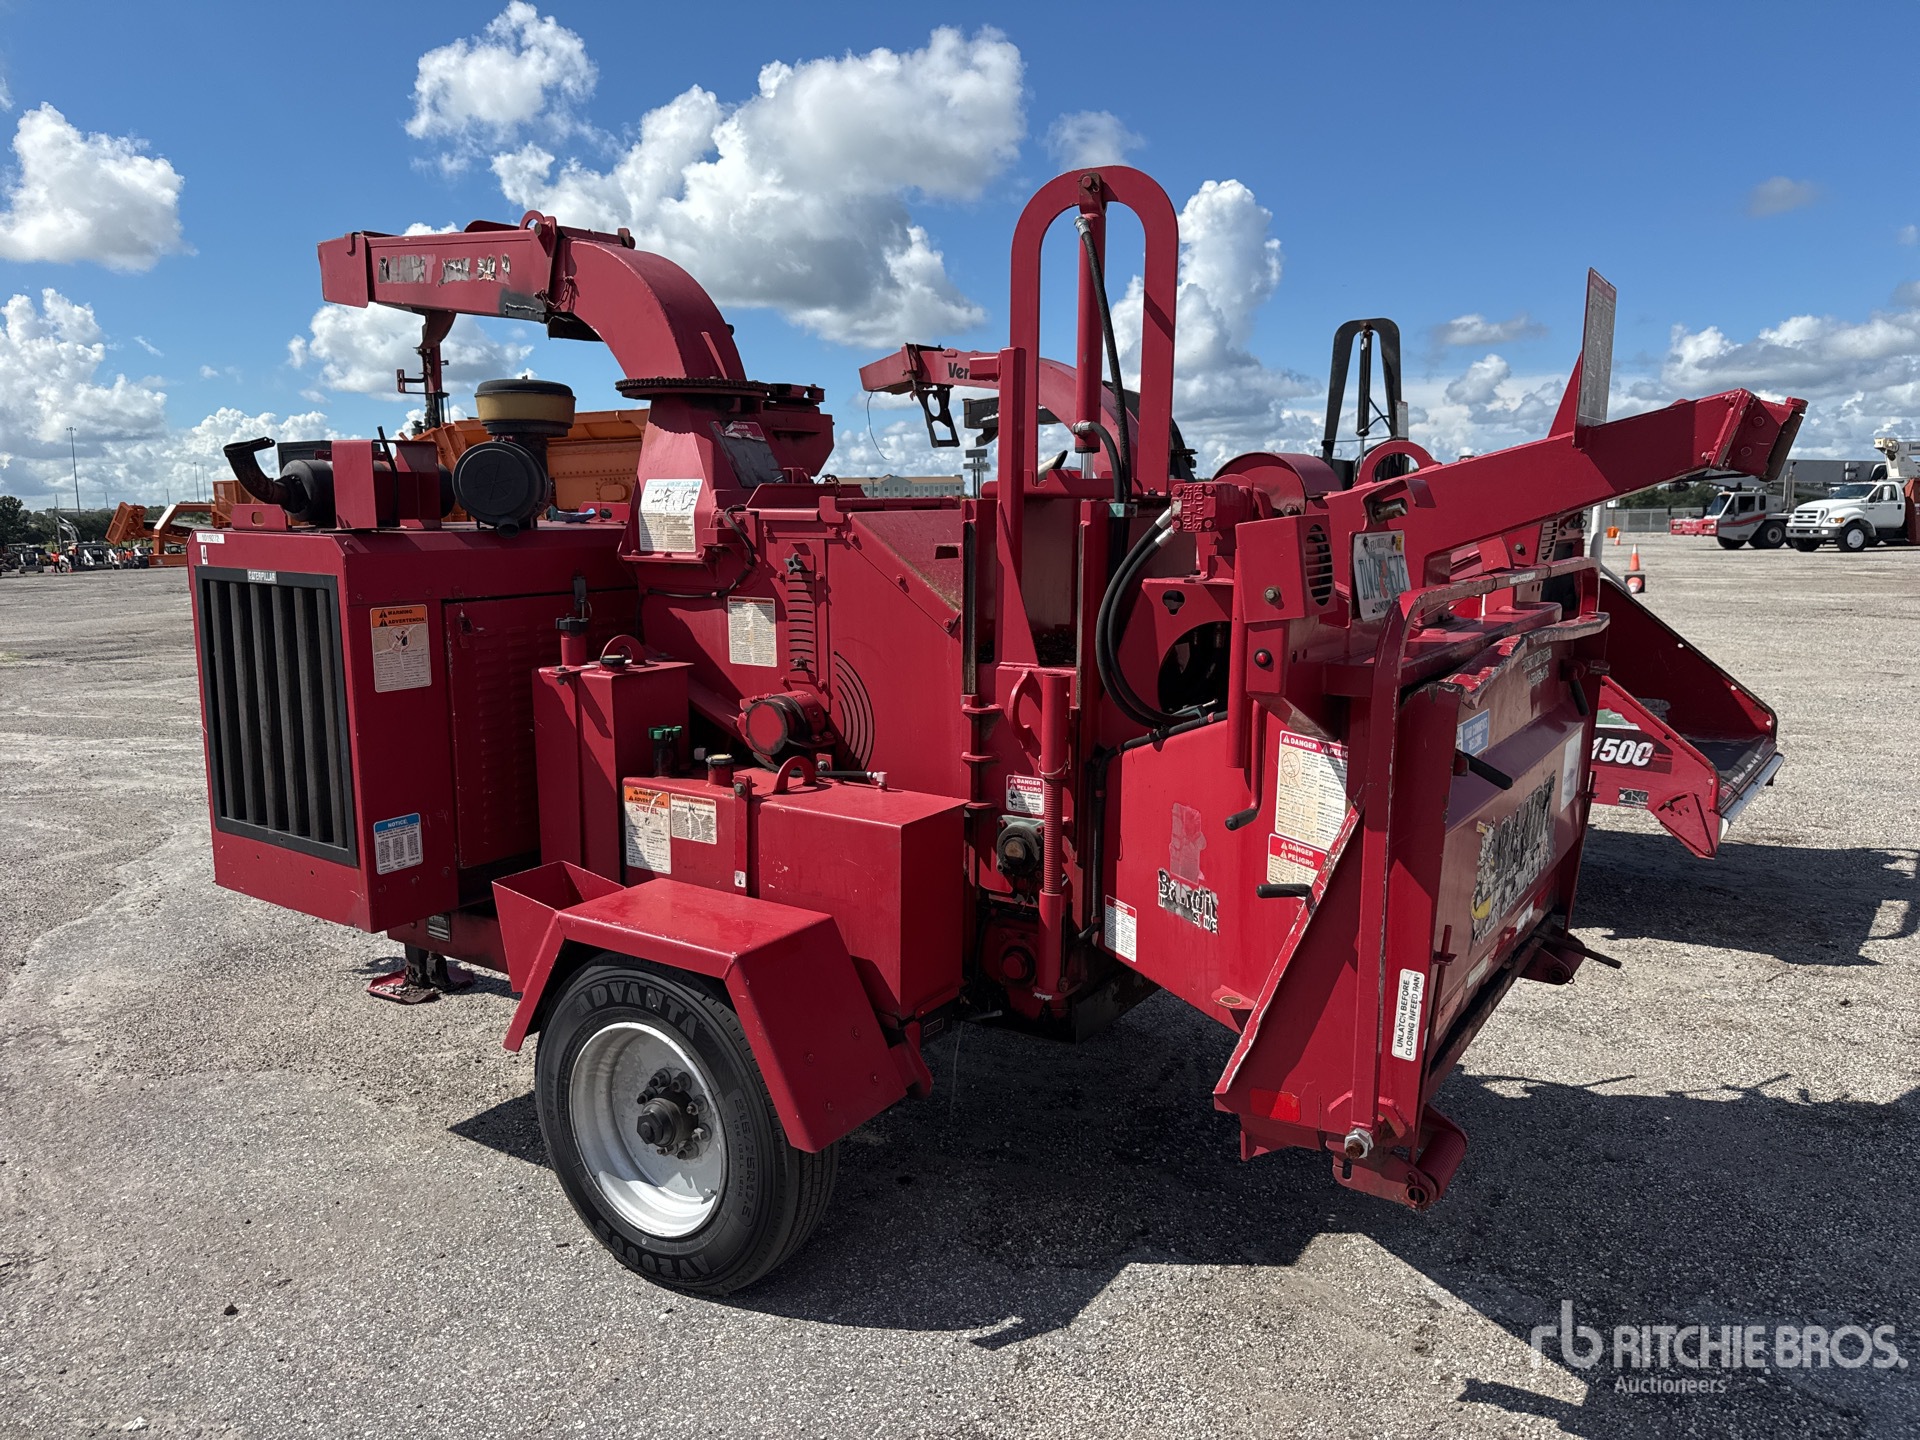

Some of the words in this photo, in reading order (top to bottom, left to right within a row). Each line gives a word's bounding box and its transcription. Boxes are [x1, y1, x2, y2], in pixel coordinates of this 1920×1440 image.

[1183, 485, 1192, 530] ROLLER
[1193, 485, 1203, 530] STATOR
[248, 570, 275, 582] CATERPILLAR
[1291, 738, 1317, 750] DANGER
[1330, 747, 1348, 759] PELIG
[1016, 778, 1041, 786] DANGER
[1016, 785, 1042, 793] PELIGRO
[388, 819, 407, 828] NOTICE
[1287, 853, 1315, 867] PELIGRO
[1288, 843, 1314, 857] DANGER
[1401, 979, 1410, 1011] BEFORE
[1409, 993, 1418, 1021] INFEED
[577, 981, 699, 1041] ADVANTA
[1397, 1012, 1406, 1048] UNLATCH
[1405, 1023, 1415, 1056] CLOSING
